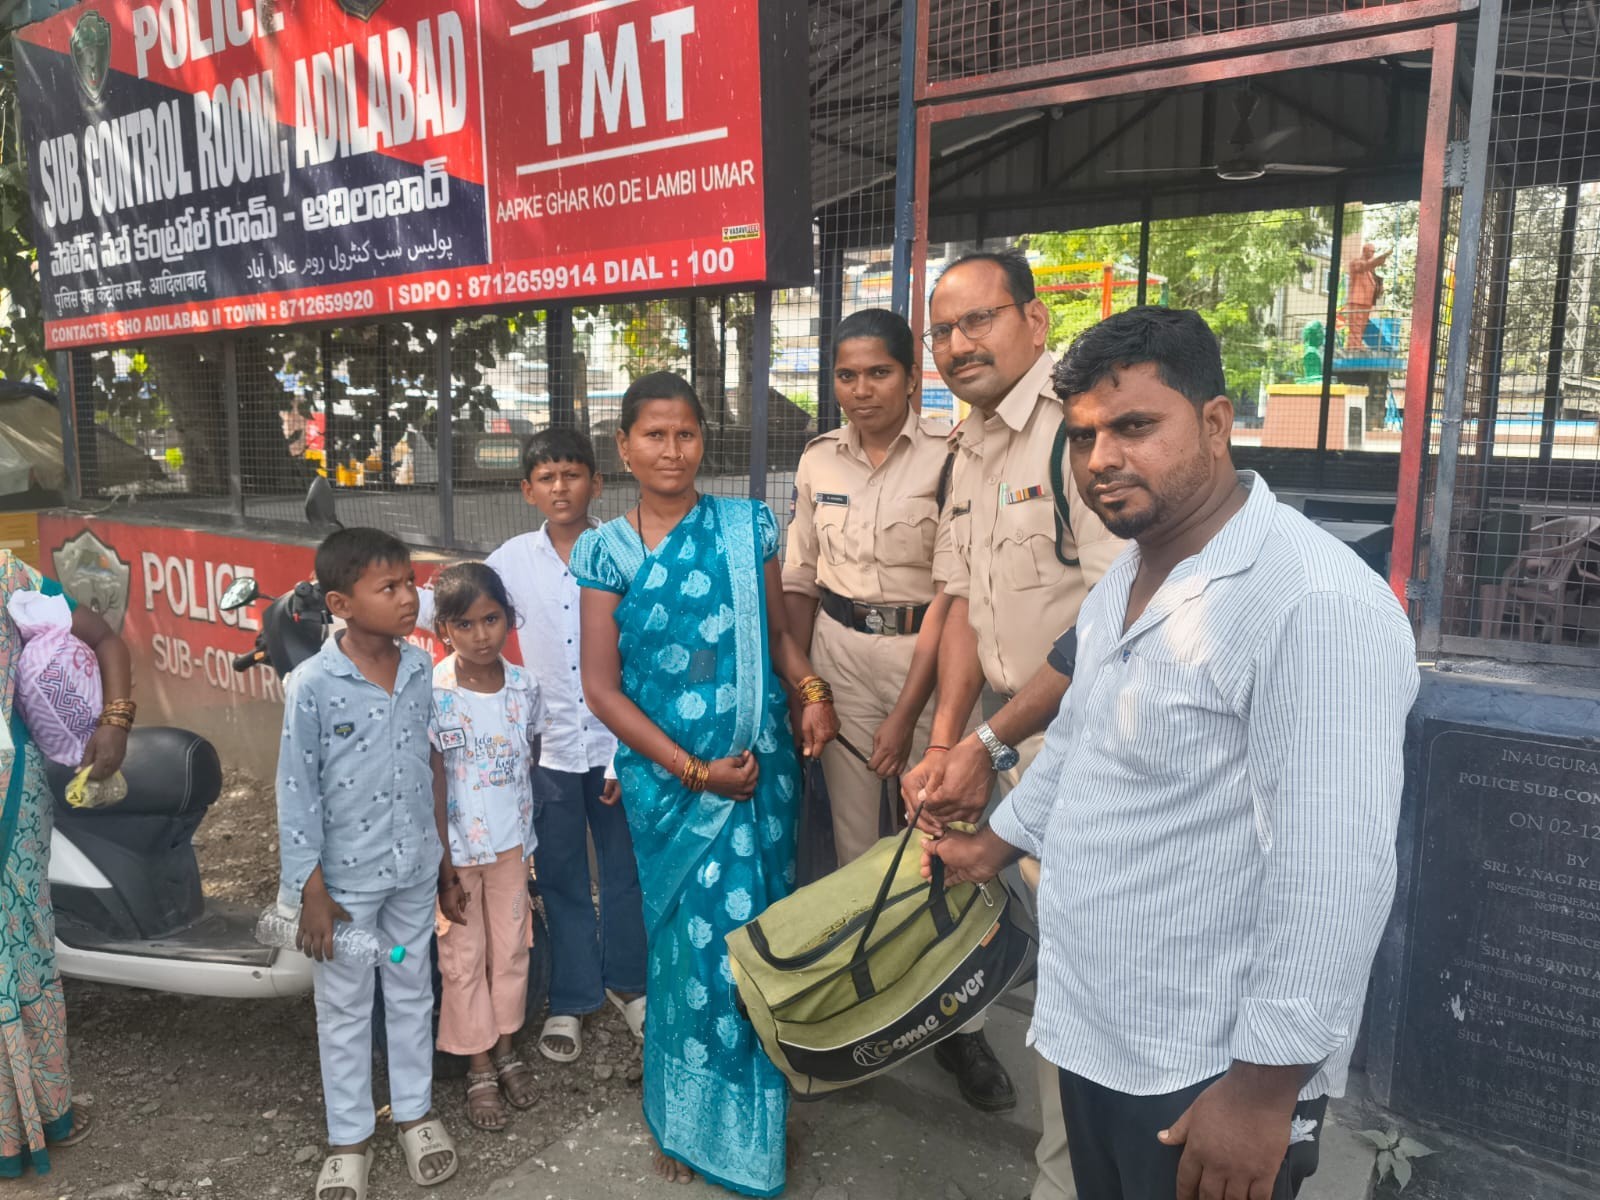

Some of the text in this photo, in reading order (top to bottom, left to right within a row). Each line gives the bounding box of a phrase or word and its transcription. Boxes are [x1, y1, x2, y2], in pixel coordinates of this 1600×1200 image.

[532, 6, 695, 146] TMT
[39, 10, 467, 228] SUB CONTROL ROOM, ADILABAD
[496, 159, 755, 224] AAPKE GHAR KO DE LAMBI UMAR
[51, 322, 108, 343] CONTACTS
[116, 316, 141, 337] SHO
[145, 309, 209, 333] ADILABAD
[225, 302, 267, 323] TOWN
[279, 289, 374, 319] 8712659920
[398, 280, 450, 306] SDPO
[468, 262, 597, 299] 8712659914
[603, 256, 664, 284] DIAL
[686, 247, 735, 275] 100
[141, 551, 260, 632] POLICE
[1458, 771, 1521, 792] POLICE
[1508, 811, 1545, 831] ON
[1481, 859, 1510, 874] SRI.
[1514, 865, 1528, 878] Y.
[1531, 868, 1574, 886] NAGI
[1566, 853, 1590, 869] BY
[1487, 880, 1546, 900] INSPECTOR
[1517, 924, 1600, 950] IN PRESENCE
[873, 969, 985, 1057] Game Over
[1521, 999, 1587, 1025] PANASA
[1507, 1040, 1556, 1063] LAXMI
